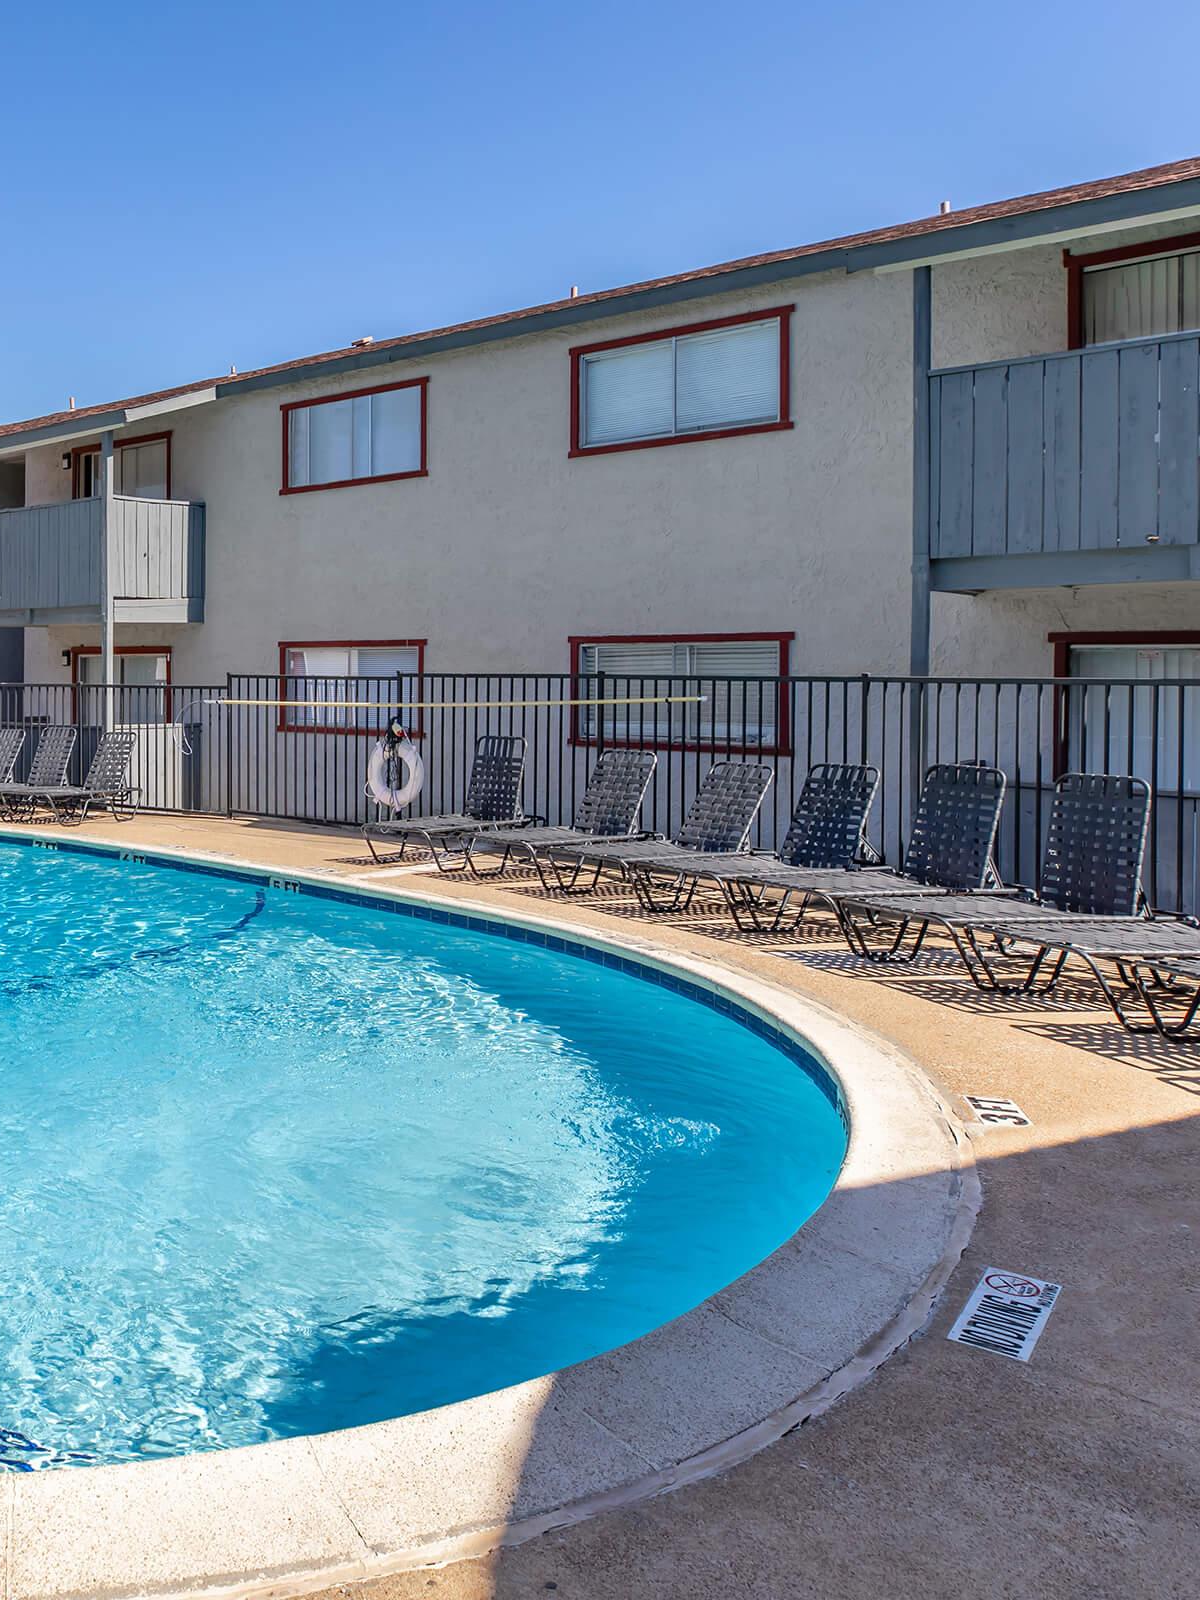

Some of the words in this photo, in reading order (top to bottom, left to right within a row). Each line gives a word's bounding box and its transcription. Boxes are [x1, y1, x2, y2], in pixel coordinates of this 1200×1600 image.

[966, 1096, 1019, 1113] FT
[981, 1113, 1029, 1125] 3
[967, 1295, 1042, 1341] DIVING
[958, 1329, 1023, 1357] NO
